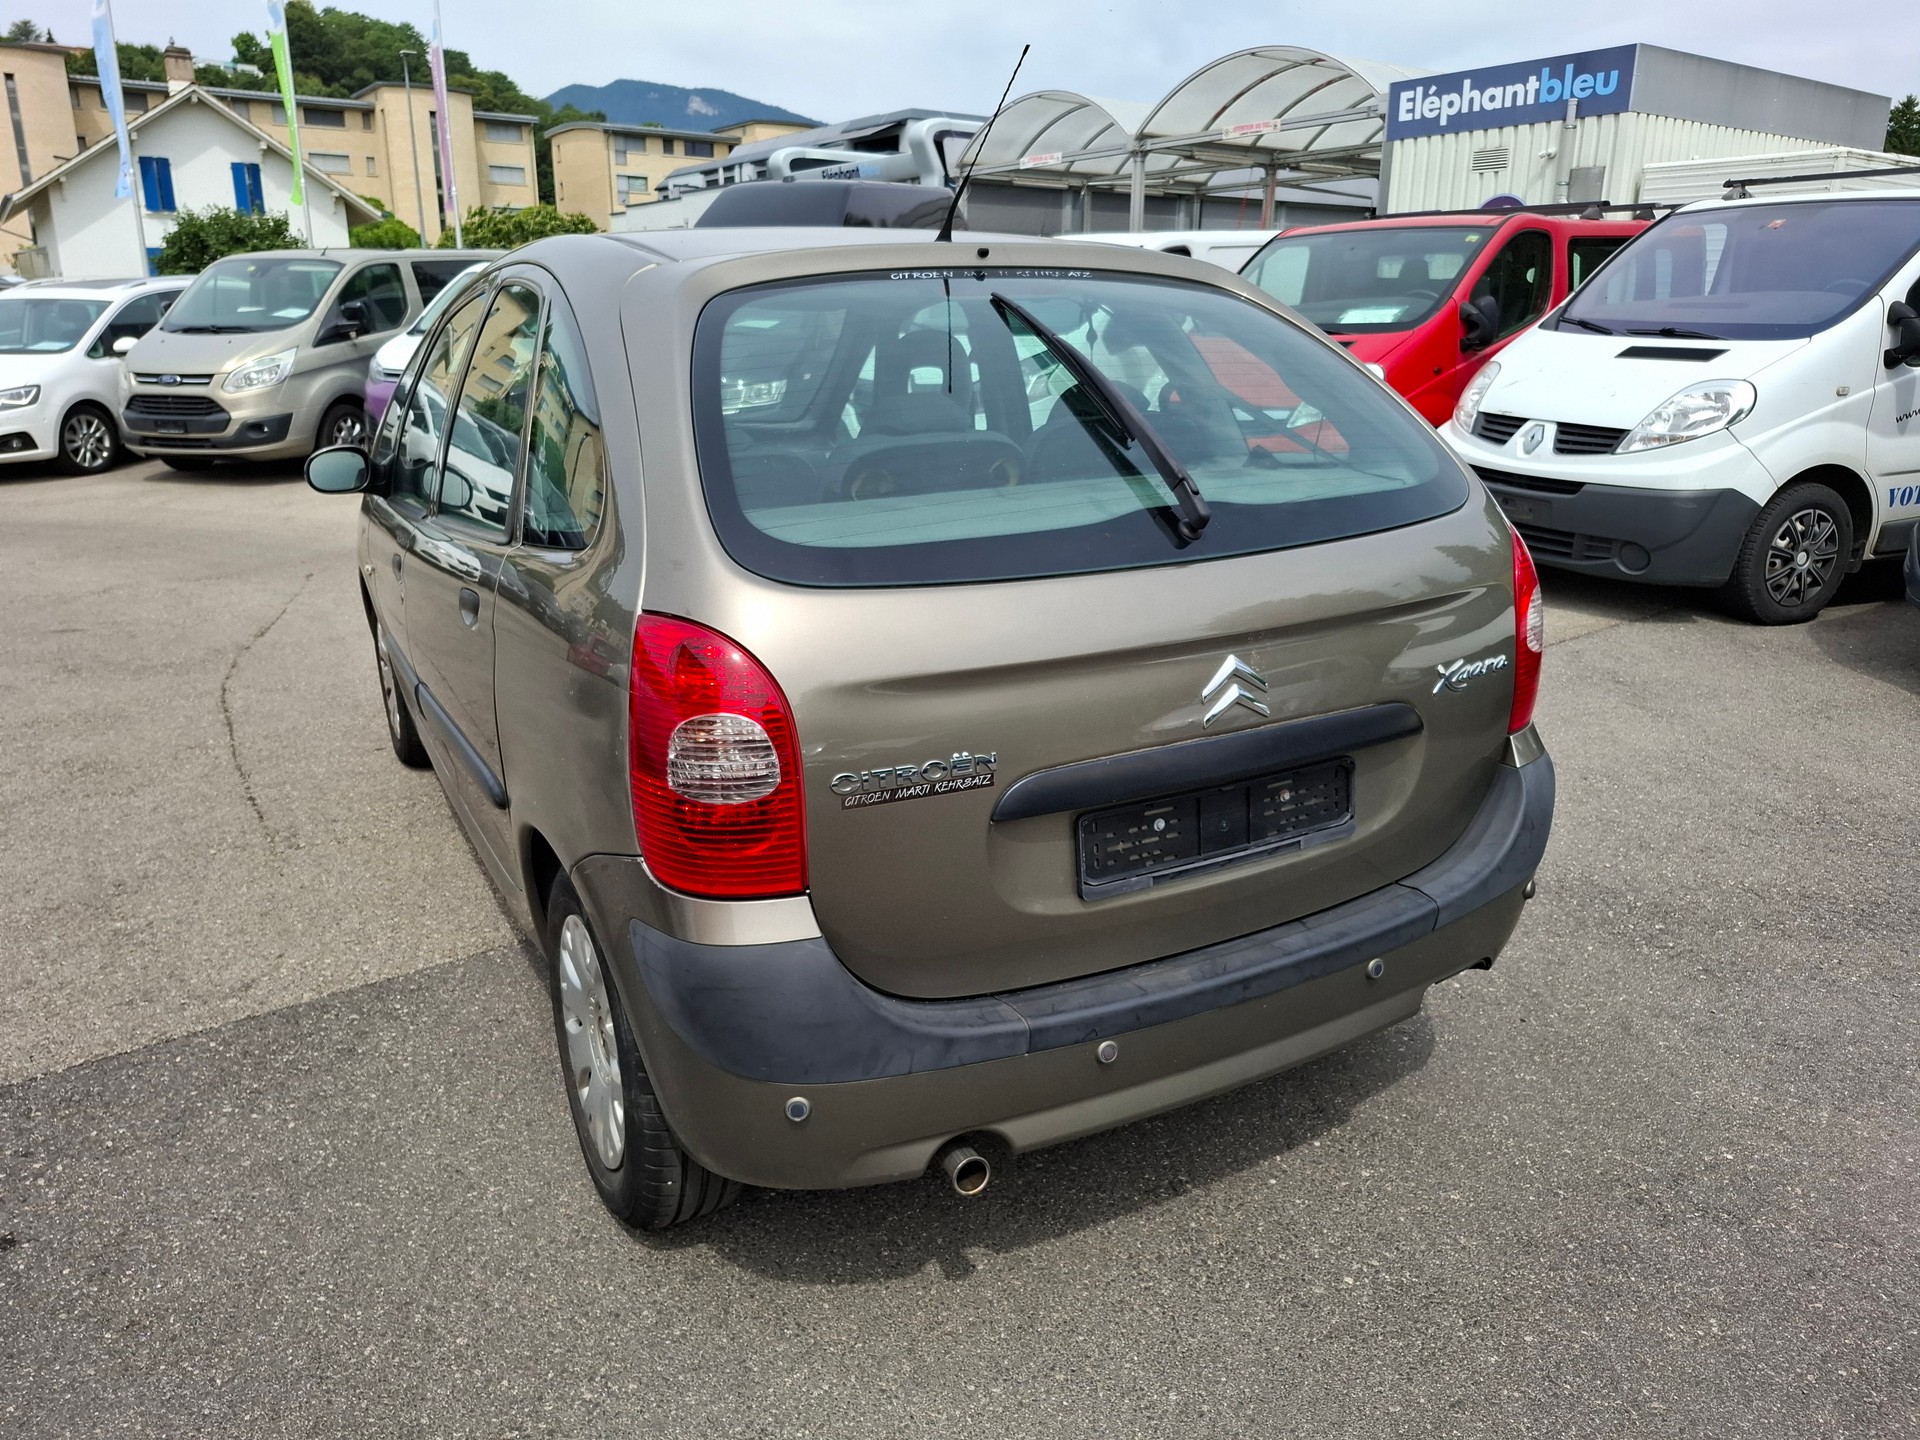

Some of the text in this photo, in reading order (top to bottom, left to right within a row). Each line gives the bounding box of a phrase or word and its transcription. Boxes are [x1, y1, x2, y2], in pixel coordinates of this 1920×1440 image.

[845, 774, 992, 807] CITROEN MARTI KEHRSATZ
